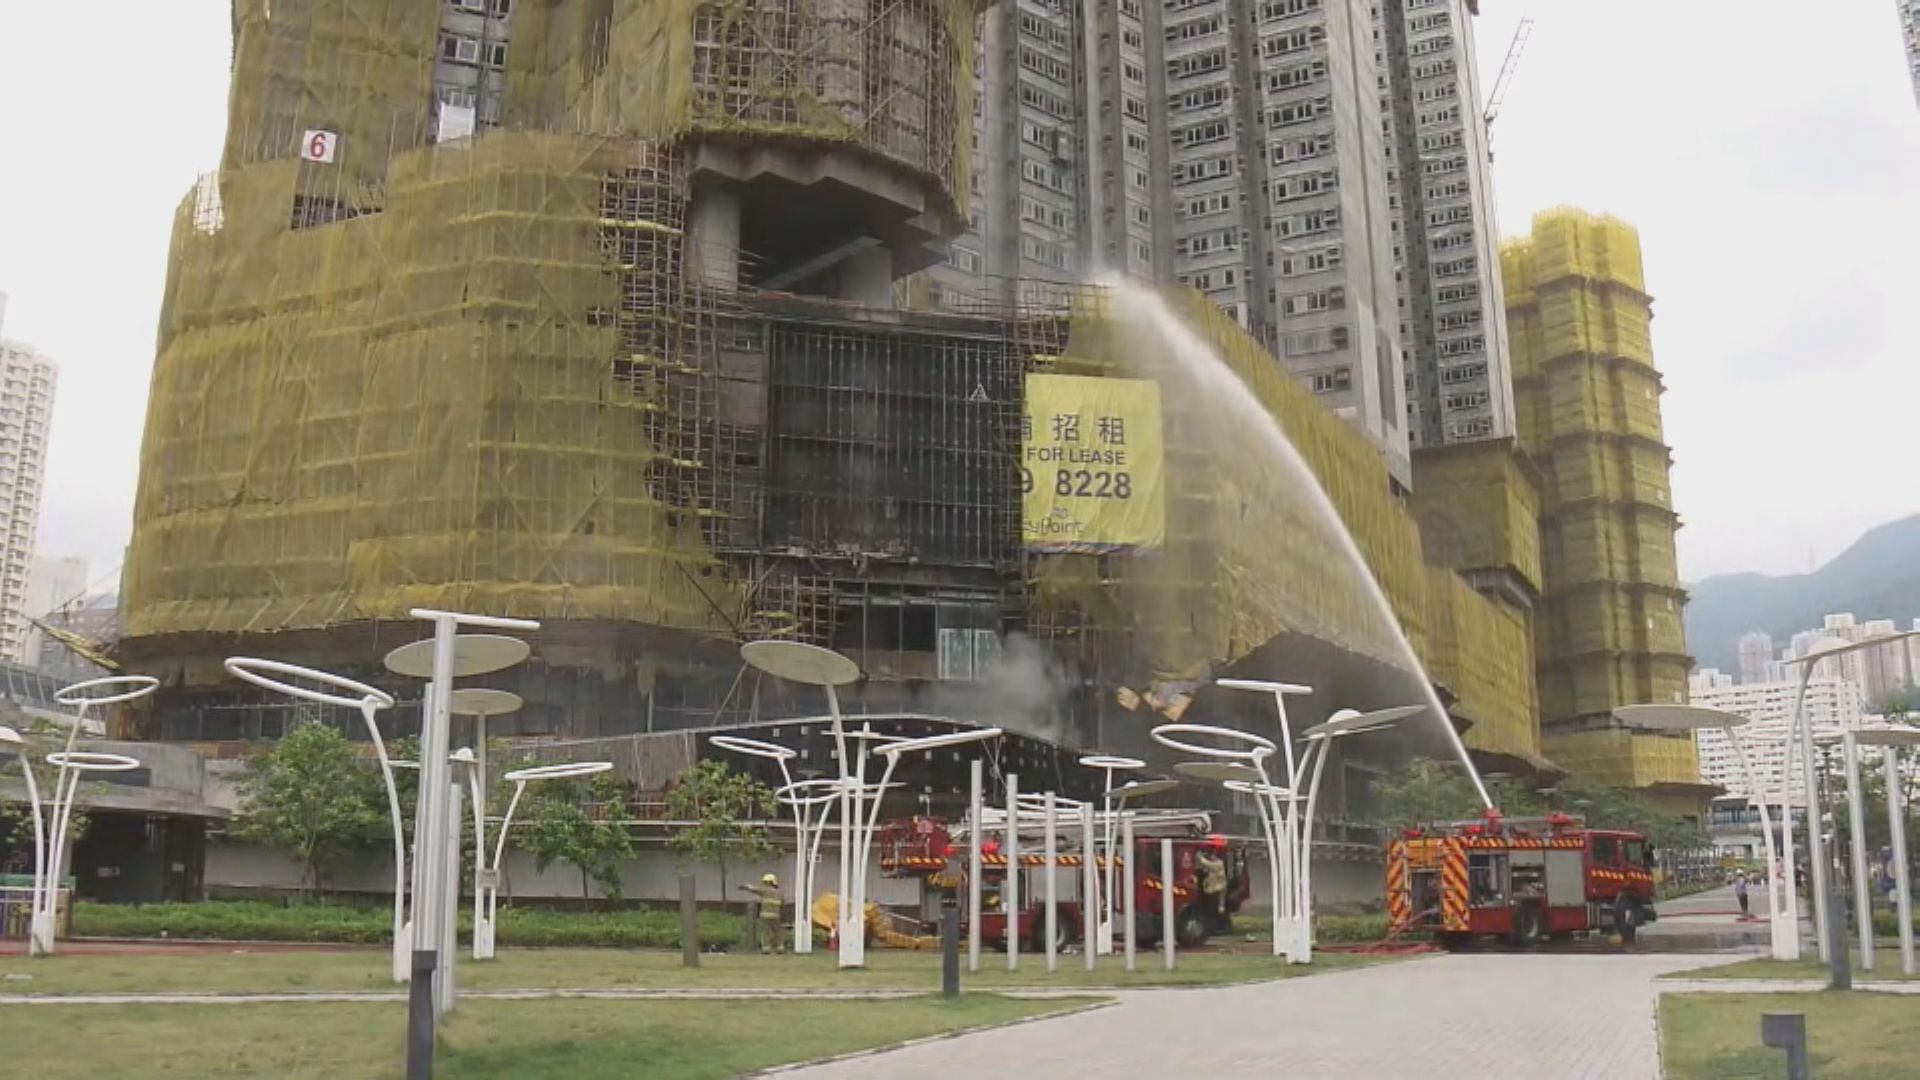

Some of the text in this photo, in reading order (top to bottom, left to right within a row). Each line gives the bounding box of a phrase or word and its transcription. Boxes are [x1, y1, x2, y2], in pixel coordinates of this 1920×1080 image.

[311, 133, 326, 159] 6
[1026, 447, 1127, 465] FOR LEASE
[1055, 469, 1132, 499] 8228
